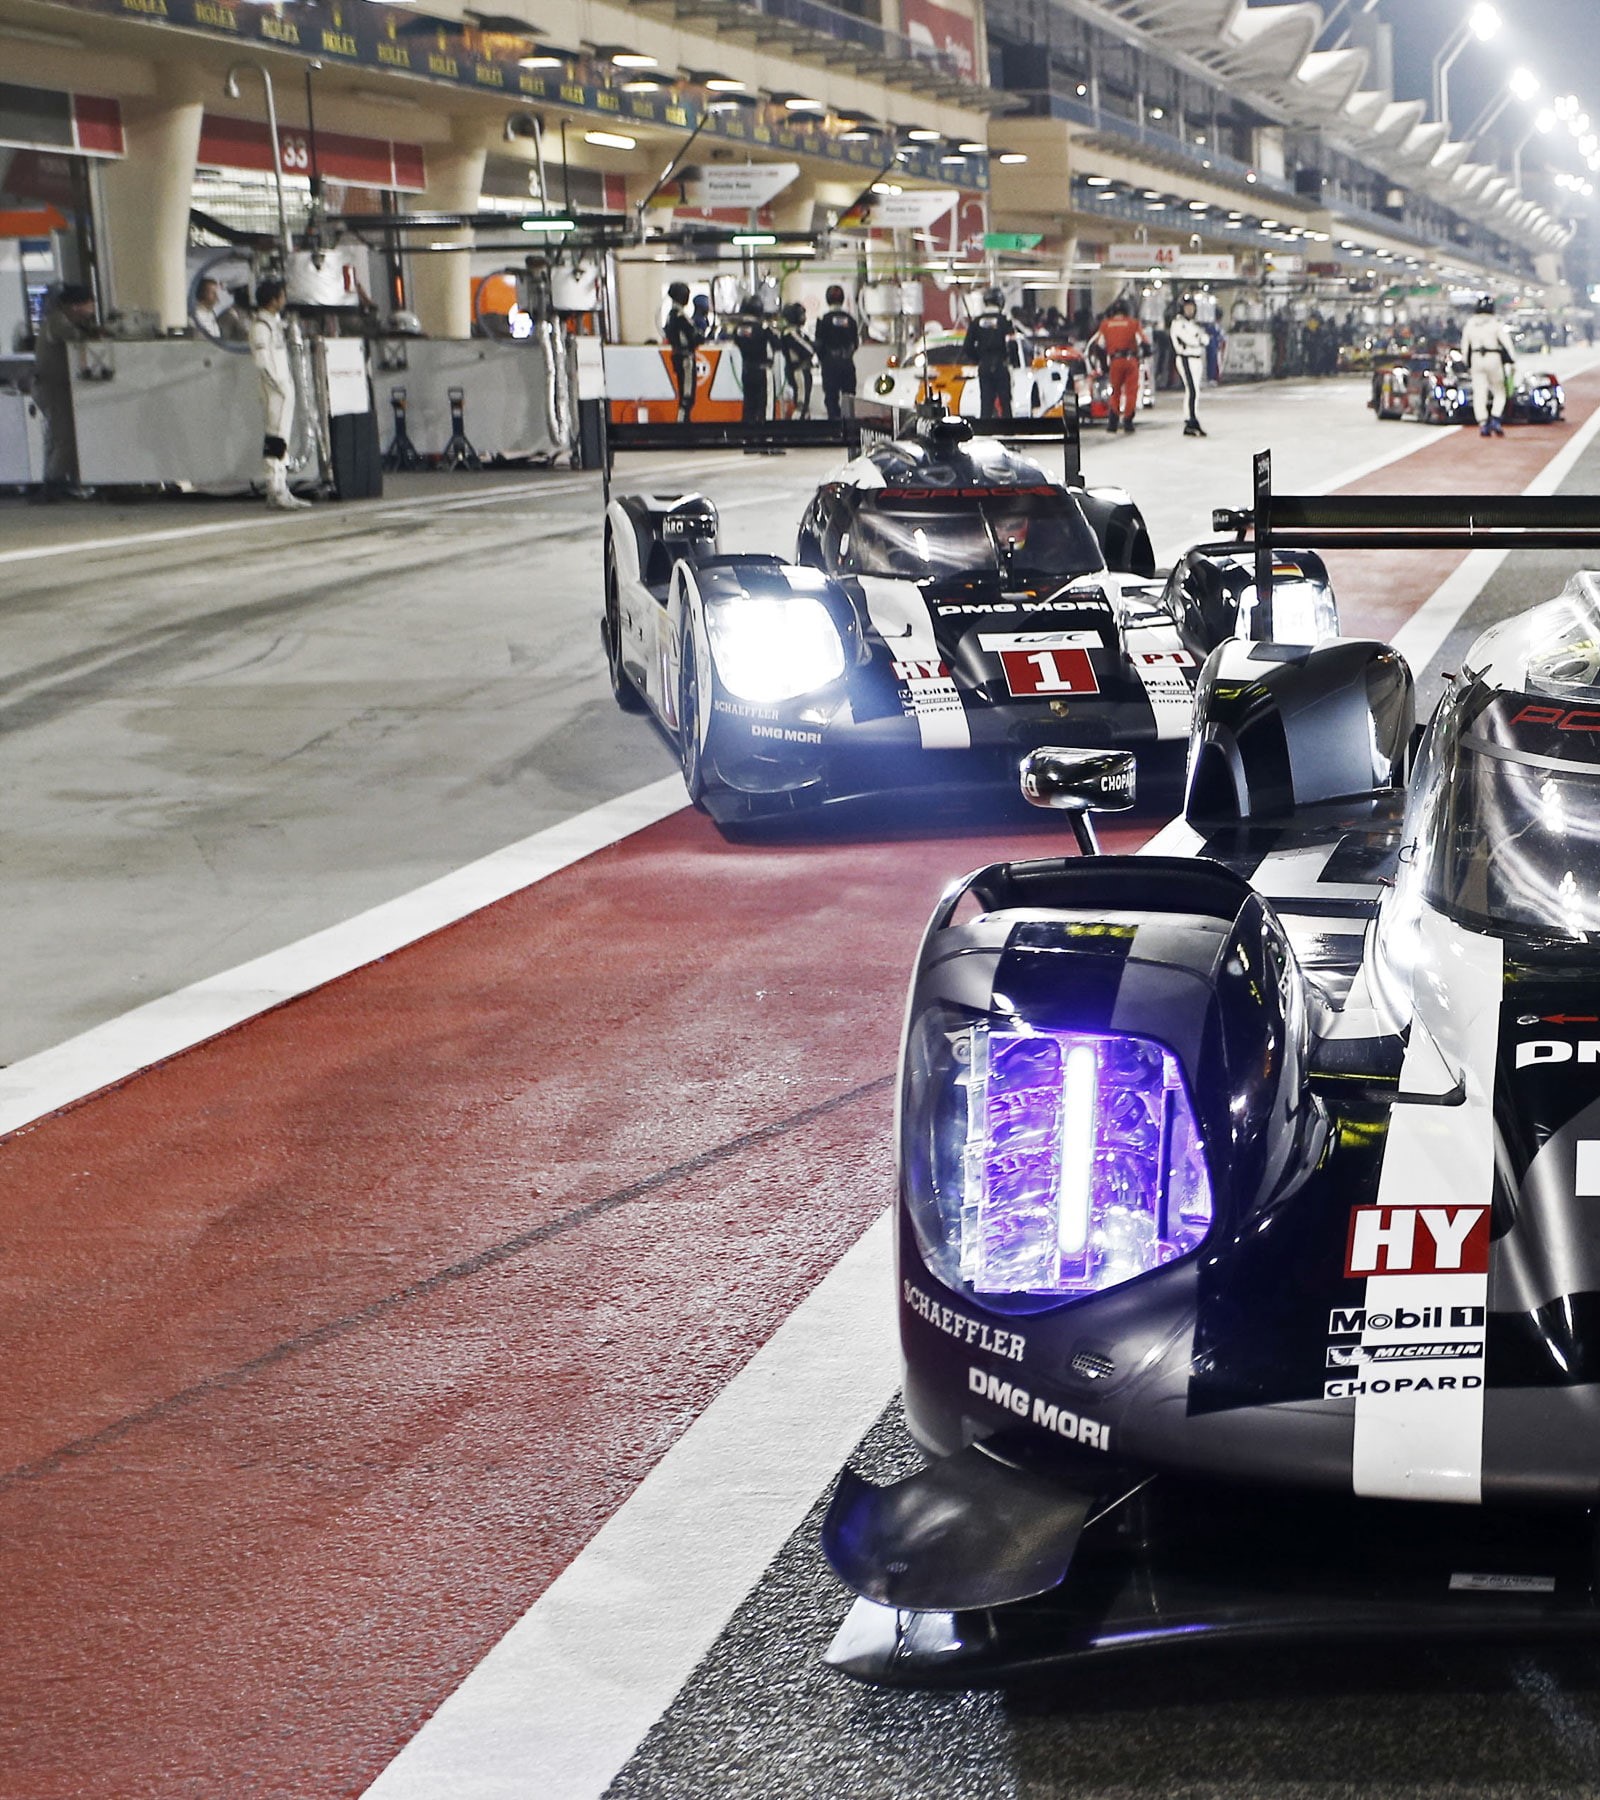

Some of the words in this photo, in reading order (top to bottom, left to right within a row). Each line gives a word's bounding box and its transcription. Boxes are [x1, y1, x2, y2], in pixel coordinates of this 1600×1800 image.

[879, 486, 1057, 499] PORSCHE
[937, 602, 1017, 617] DMG
[1022, 602, 1110, 613] MORI
[1142, 653, 1184, 664] P1
[892, 660, 941, 680] HY
[1027, 652, 1072, 692] 1
[714, 700, 779, 720] SCHAEFFLER
[751, 724, 783, 740] DMG
[784, 729, 822, 744] MORI
[1350, 1209, 1485, 1272] HY
[903, 1278, 1027, 1363] SCHAEFFLER
[1331, 1306, 1443, 1333] Mobil
[1373, 1344, 1482, 1359] MICHELIN
[1326, 1375, 1483, 1397] CHOPARD
[968, 1366, 1031, 1417] DMG
[1032, 1397, 1110, 1451] MORI
